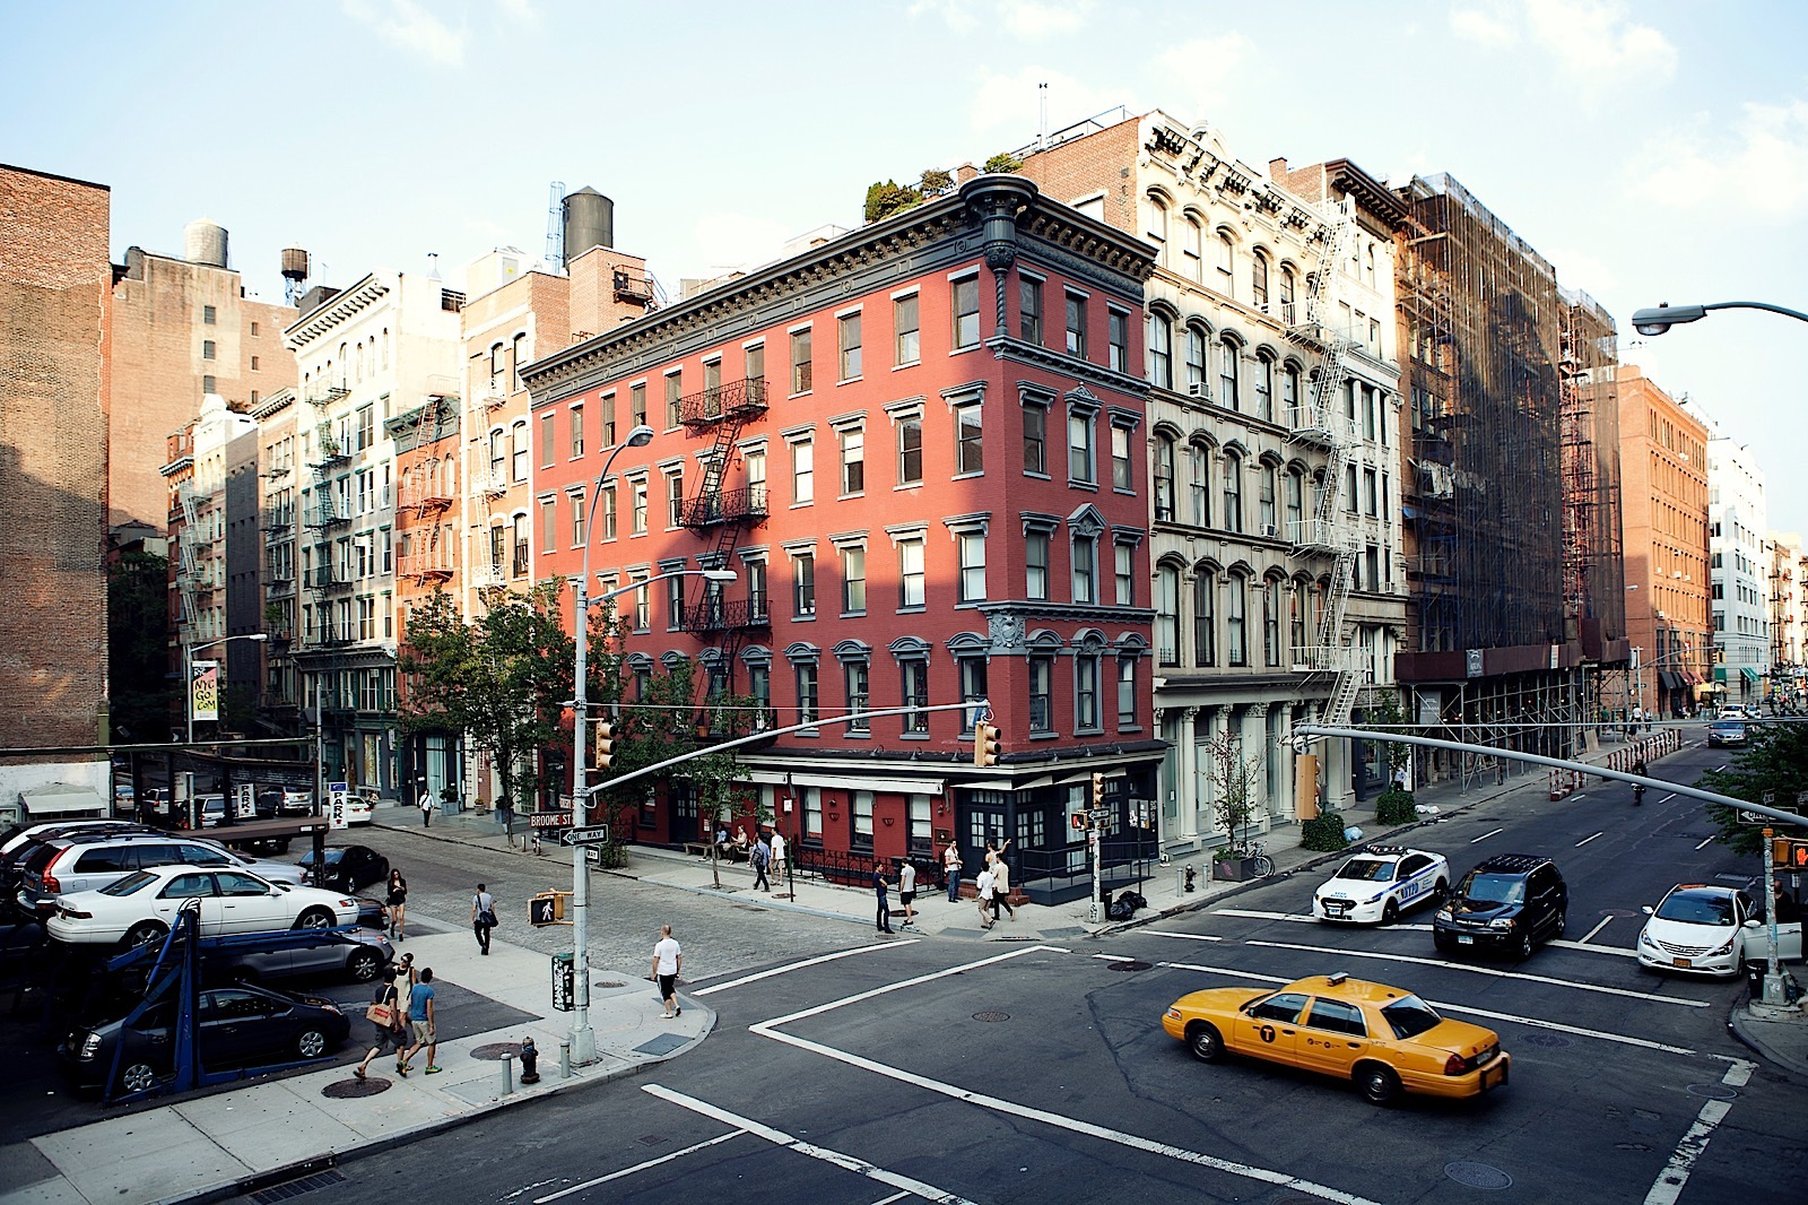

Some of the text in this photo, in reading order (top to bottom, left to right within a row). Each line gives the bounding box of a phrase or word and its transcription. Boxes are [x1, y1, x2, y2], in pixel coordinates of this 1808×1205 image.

[195, 680, 214, 690] NYC
[241, 785, 251, 809] PARK
[333, 792, 344, 819] PARK
[531, 814, 572, 827] BROOME ST
[567, 831, 601, 842] ONE WAY
[1263, 1028, 1273, 1041] T
